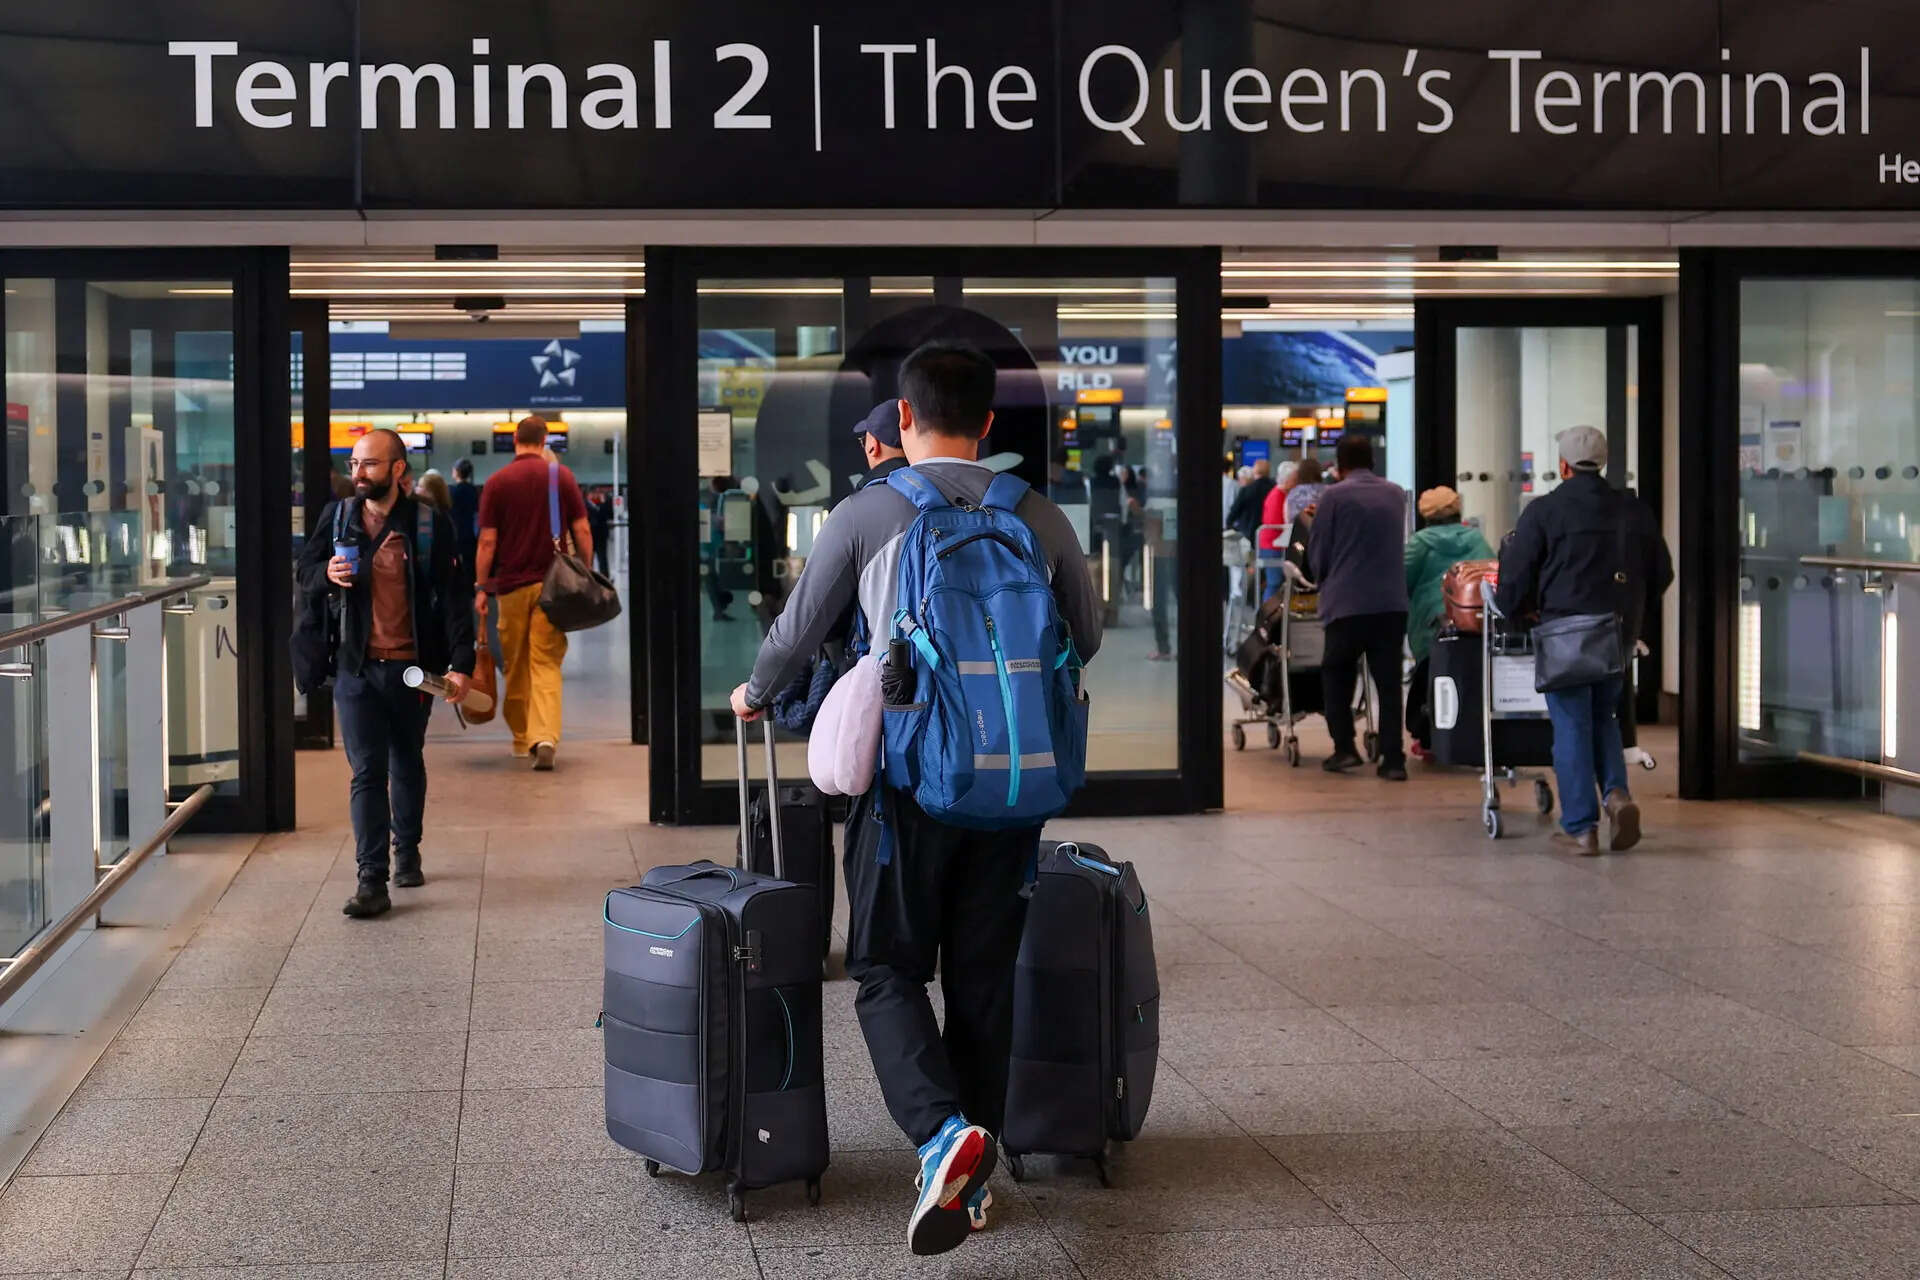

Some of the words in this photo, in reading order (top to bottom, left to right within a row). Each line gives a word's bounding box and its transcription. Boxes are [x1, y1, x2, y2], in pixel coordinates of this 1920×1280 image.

[168, 39, 671, 130] Terminal
[713, 43, 772, 129] 2
[860, 38, 1037, 131] The
[1079, 45, 1454, 146] Queen's
[1488, 47, 1870, 136] Terminal
[1059, 345, 1118, 365] YOU
